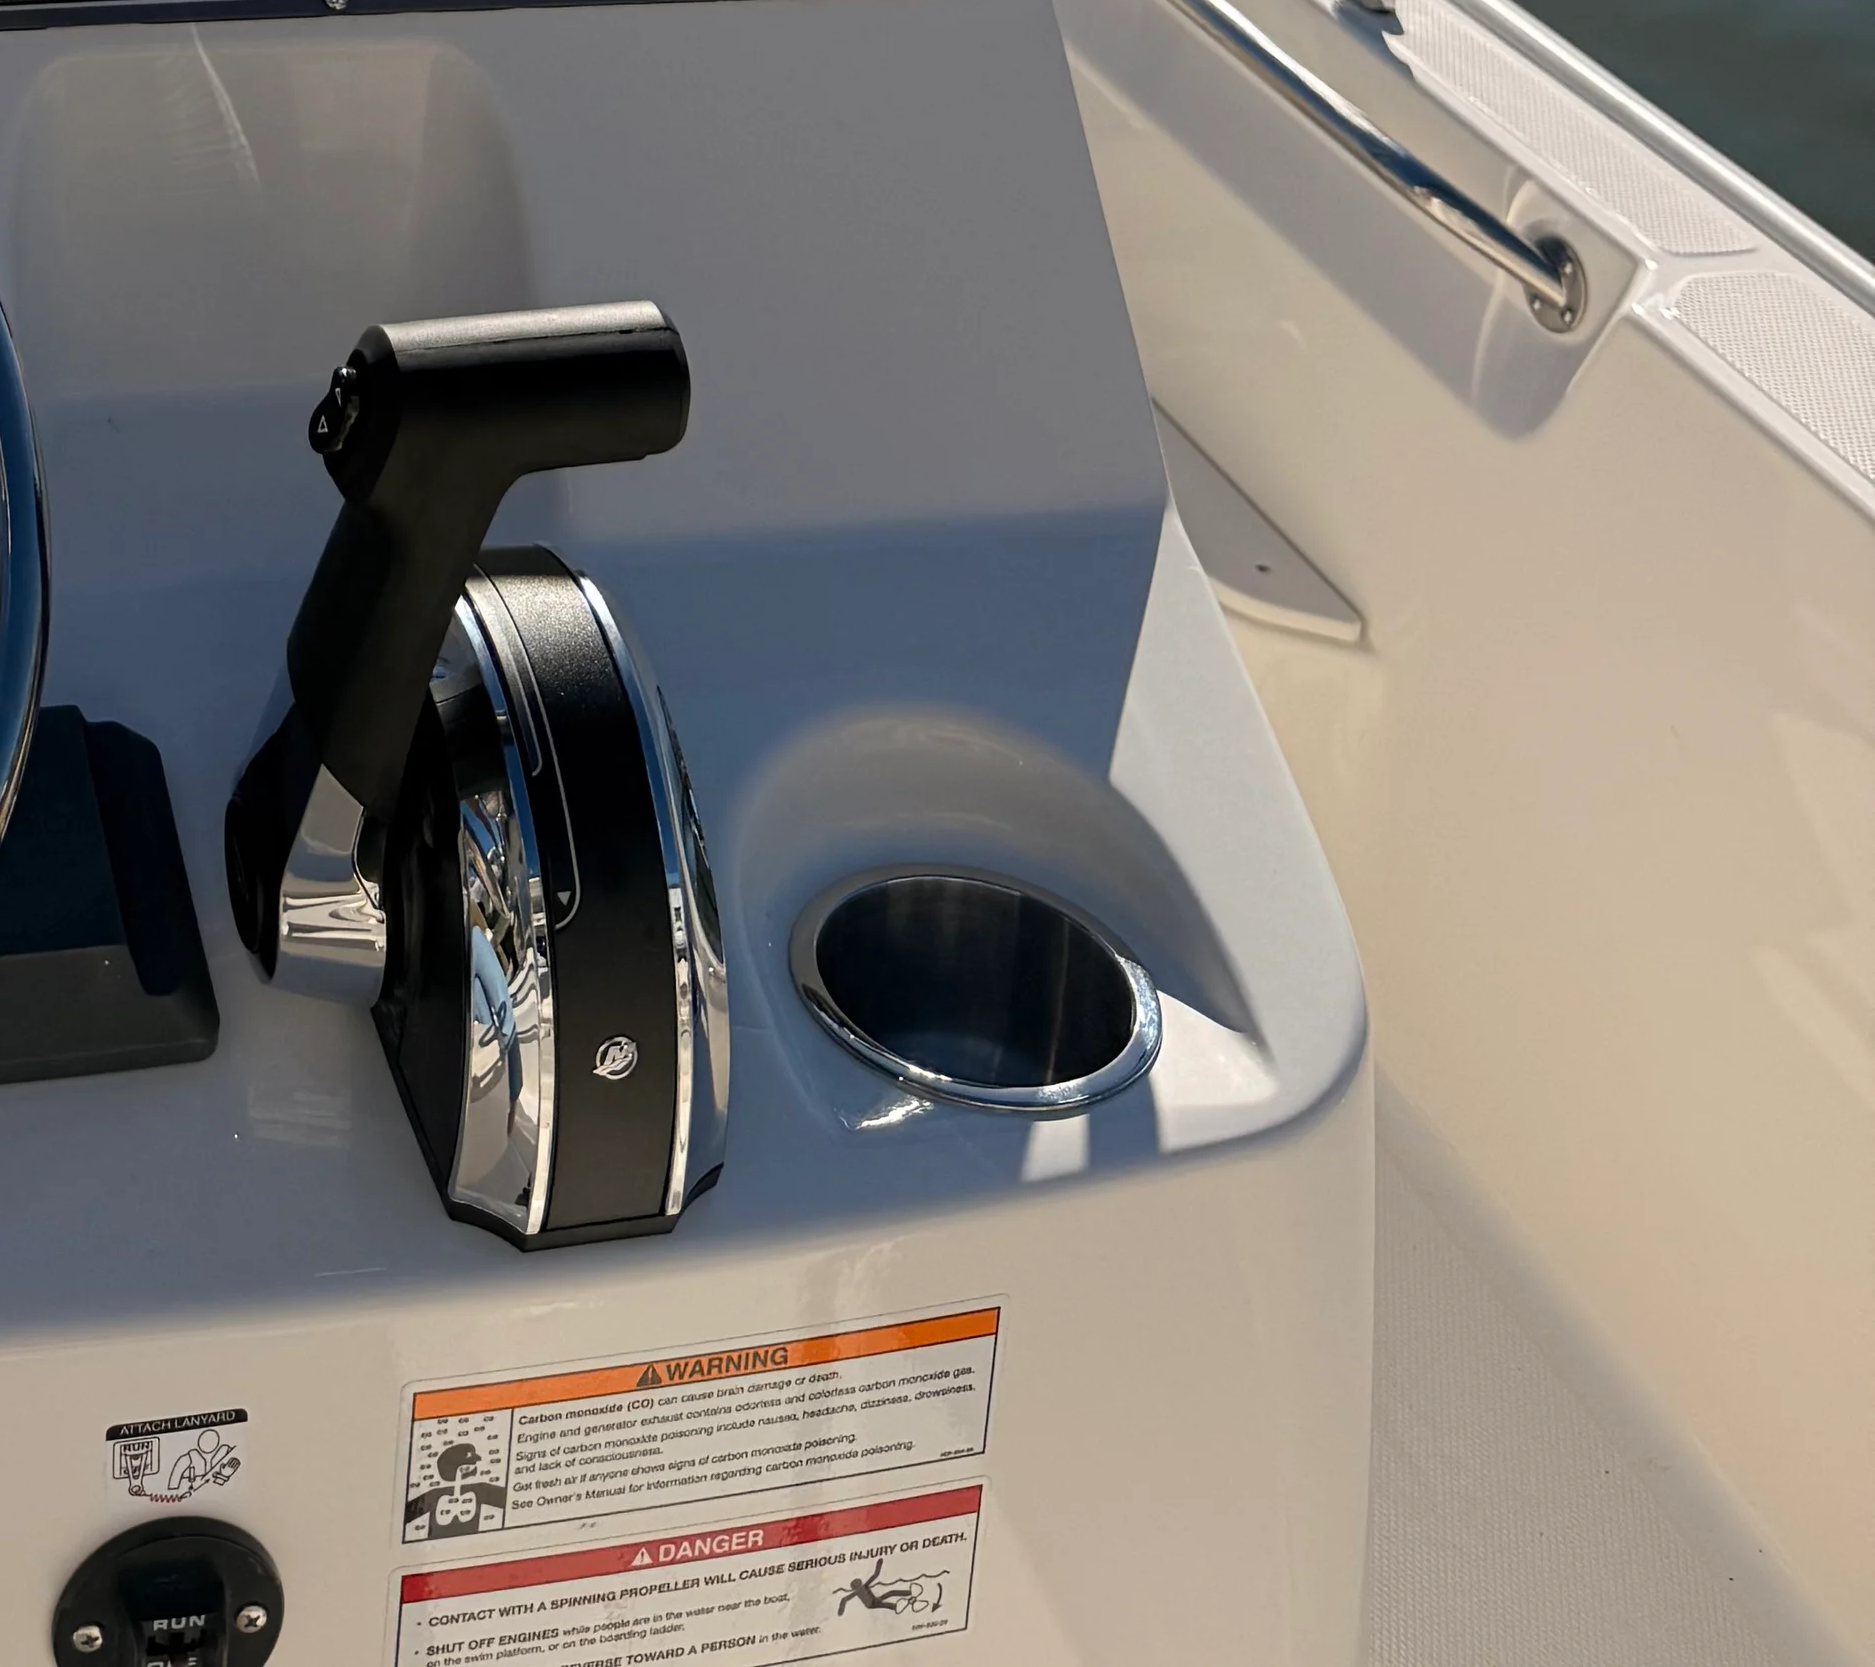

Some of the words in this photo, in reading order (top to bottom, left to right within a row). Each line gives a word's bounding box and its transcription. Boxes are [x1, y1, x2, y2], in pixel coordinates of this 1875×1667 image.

[665, 1347, 788, 1381] WARNING
[121, 1420, 171, 1435] ATTACH
[175, 1411, 235, 1428] LANYARD
[658, 1529, 763, 1563] DANGER
[429, 1609, 495, 1627] CONTACT
[499, 1603, 533, 1617] WITH
[537, 1602, 547, 1612] A
[551, 1591, 616, 1609] SPINNING
[619, 1578, 699, 1599] PROPELLER
[704, 1573, 736, 1585] WILL
[739, 1564, 785, 1580] CAUSE
[788, 1554, 845, 1572] SERIOUS
[849, 1544, 897, 1561] INJURY
[900, 1541, 918, 1552] OR
[922, 1532, 967, 1549] DEATH.
[153, 1615, 205, 1631] RUN
[626, 1647, 684, 1665] TOWARD
[687, 1645, 697, 1655] A
[701, 1635, 755, 1653] PERSON
